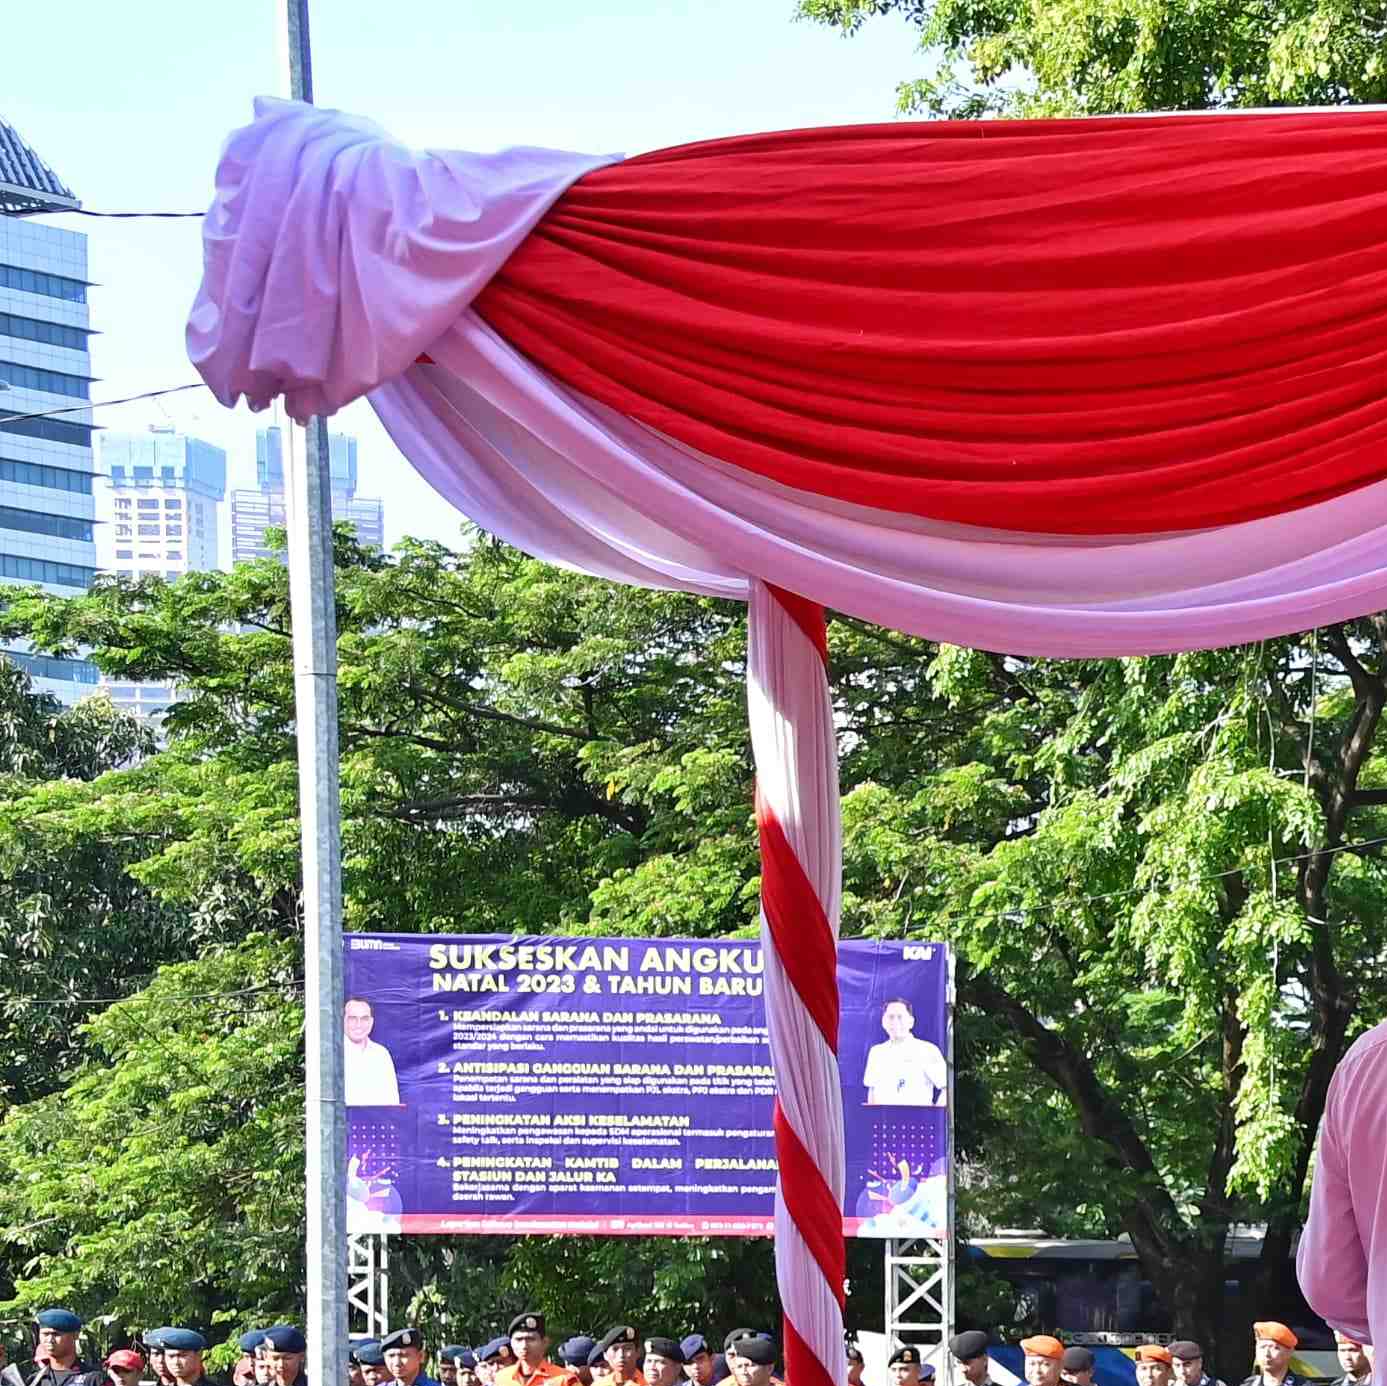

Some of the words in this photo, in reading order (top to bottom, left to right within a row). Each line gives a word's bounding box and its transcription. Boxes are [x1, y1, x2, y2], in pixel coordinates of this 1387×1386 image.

[429, 944, 629, 972] SUKSESKAN
[432, 973, 509, 992] NATAL
[517, 974, 575, 994] 2023
[583, 975, 602, 994] &
[608, 976, 691, 995] TAHUN
[700, 977, 763, 996] BARU
[439, 1011, 449, 1021] 1.
[453, 1011, 539, 1022] KEANDALAN
[542, 1012, 599, 1023] SARANA
[603, 1012, 633, 1023] DAN
[637, 1013, 721, 1024] PRASARANA
[438, 1063, 449, 1073] 2.
[453, 1063, 529, 1073] ANTISIPASI
[533, 1063, 611, 1074] GANGGUAN
[613, 1064, 671, 1075] SARANA
[673, 1065, 704, 1075] DAN
[453, 1114, 551, 1125] PENINGKATAN
[553, 1115, 585, 1125] AKSI
[588, 1115, 690, 1127] KESELAMATAN
[437, 1157, 450, 1167] 4.
[453, 1157, 552, 1168] PENINGKATAN
[565, 1157, 619, 1168] KAMTIB
[632, 1158, 682, 1169] DALAM
[453, 1171, 511, 1181] STASIUN
[515, 1171, 546, 1181] DAN
[548, 1172, 594, 1182] JALUR
[596, 1172, 616, 1182] KA
